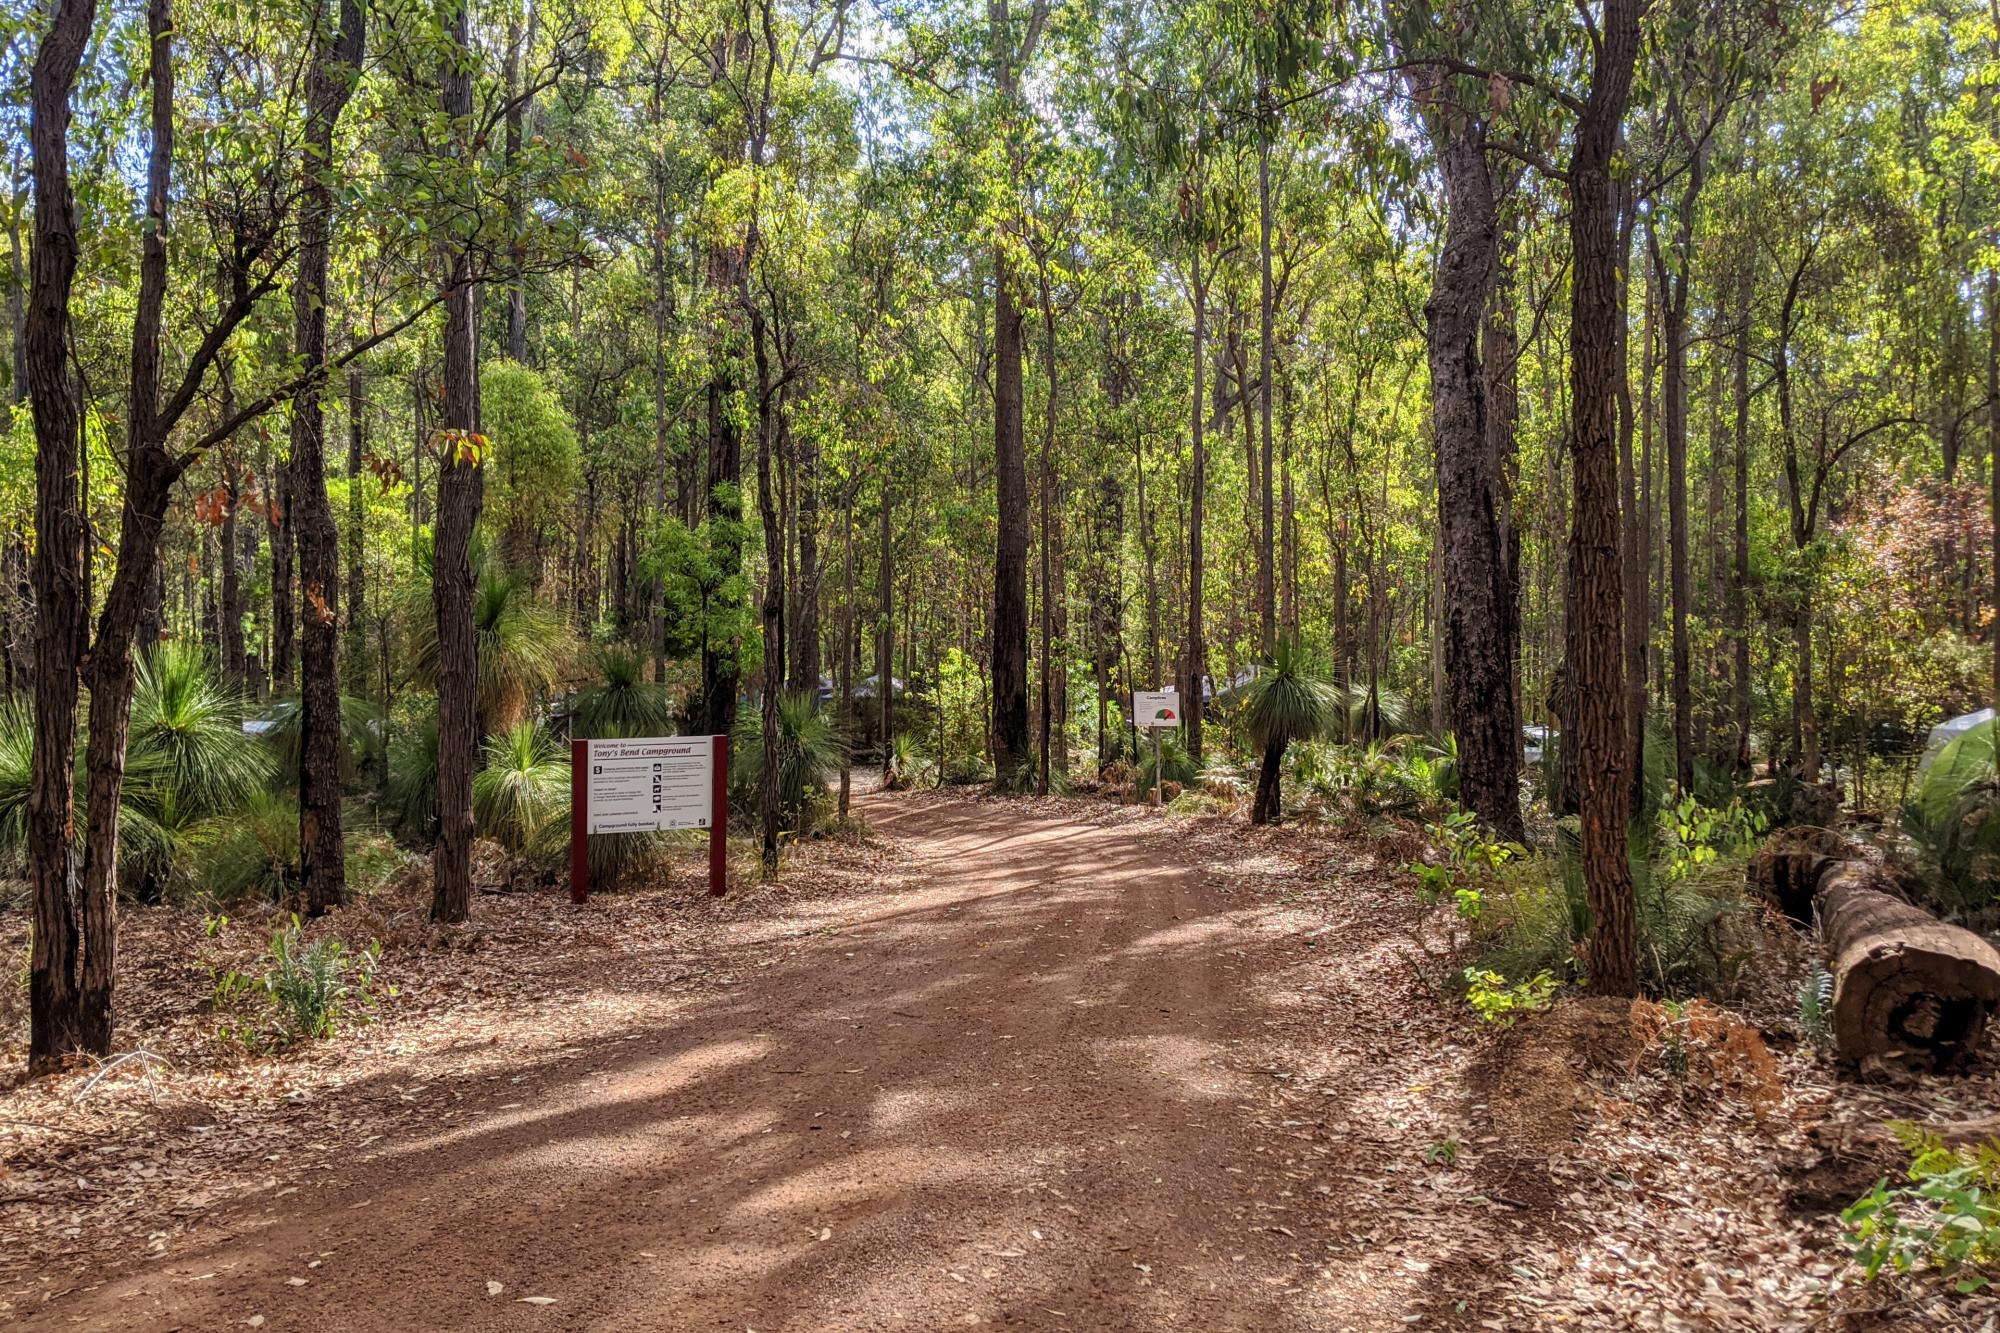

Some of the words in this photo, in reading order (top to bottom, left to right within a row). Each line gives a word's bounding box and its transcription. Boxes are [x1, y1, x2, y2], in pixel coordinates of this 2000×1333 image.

[593, 749, 618, 758] Tony's
[620, 748, 640, 757] Bend
[641, 747, 691, 756] Campground
